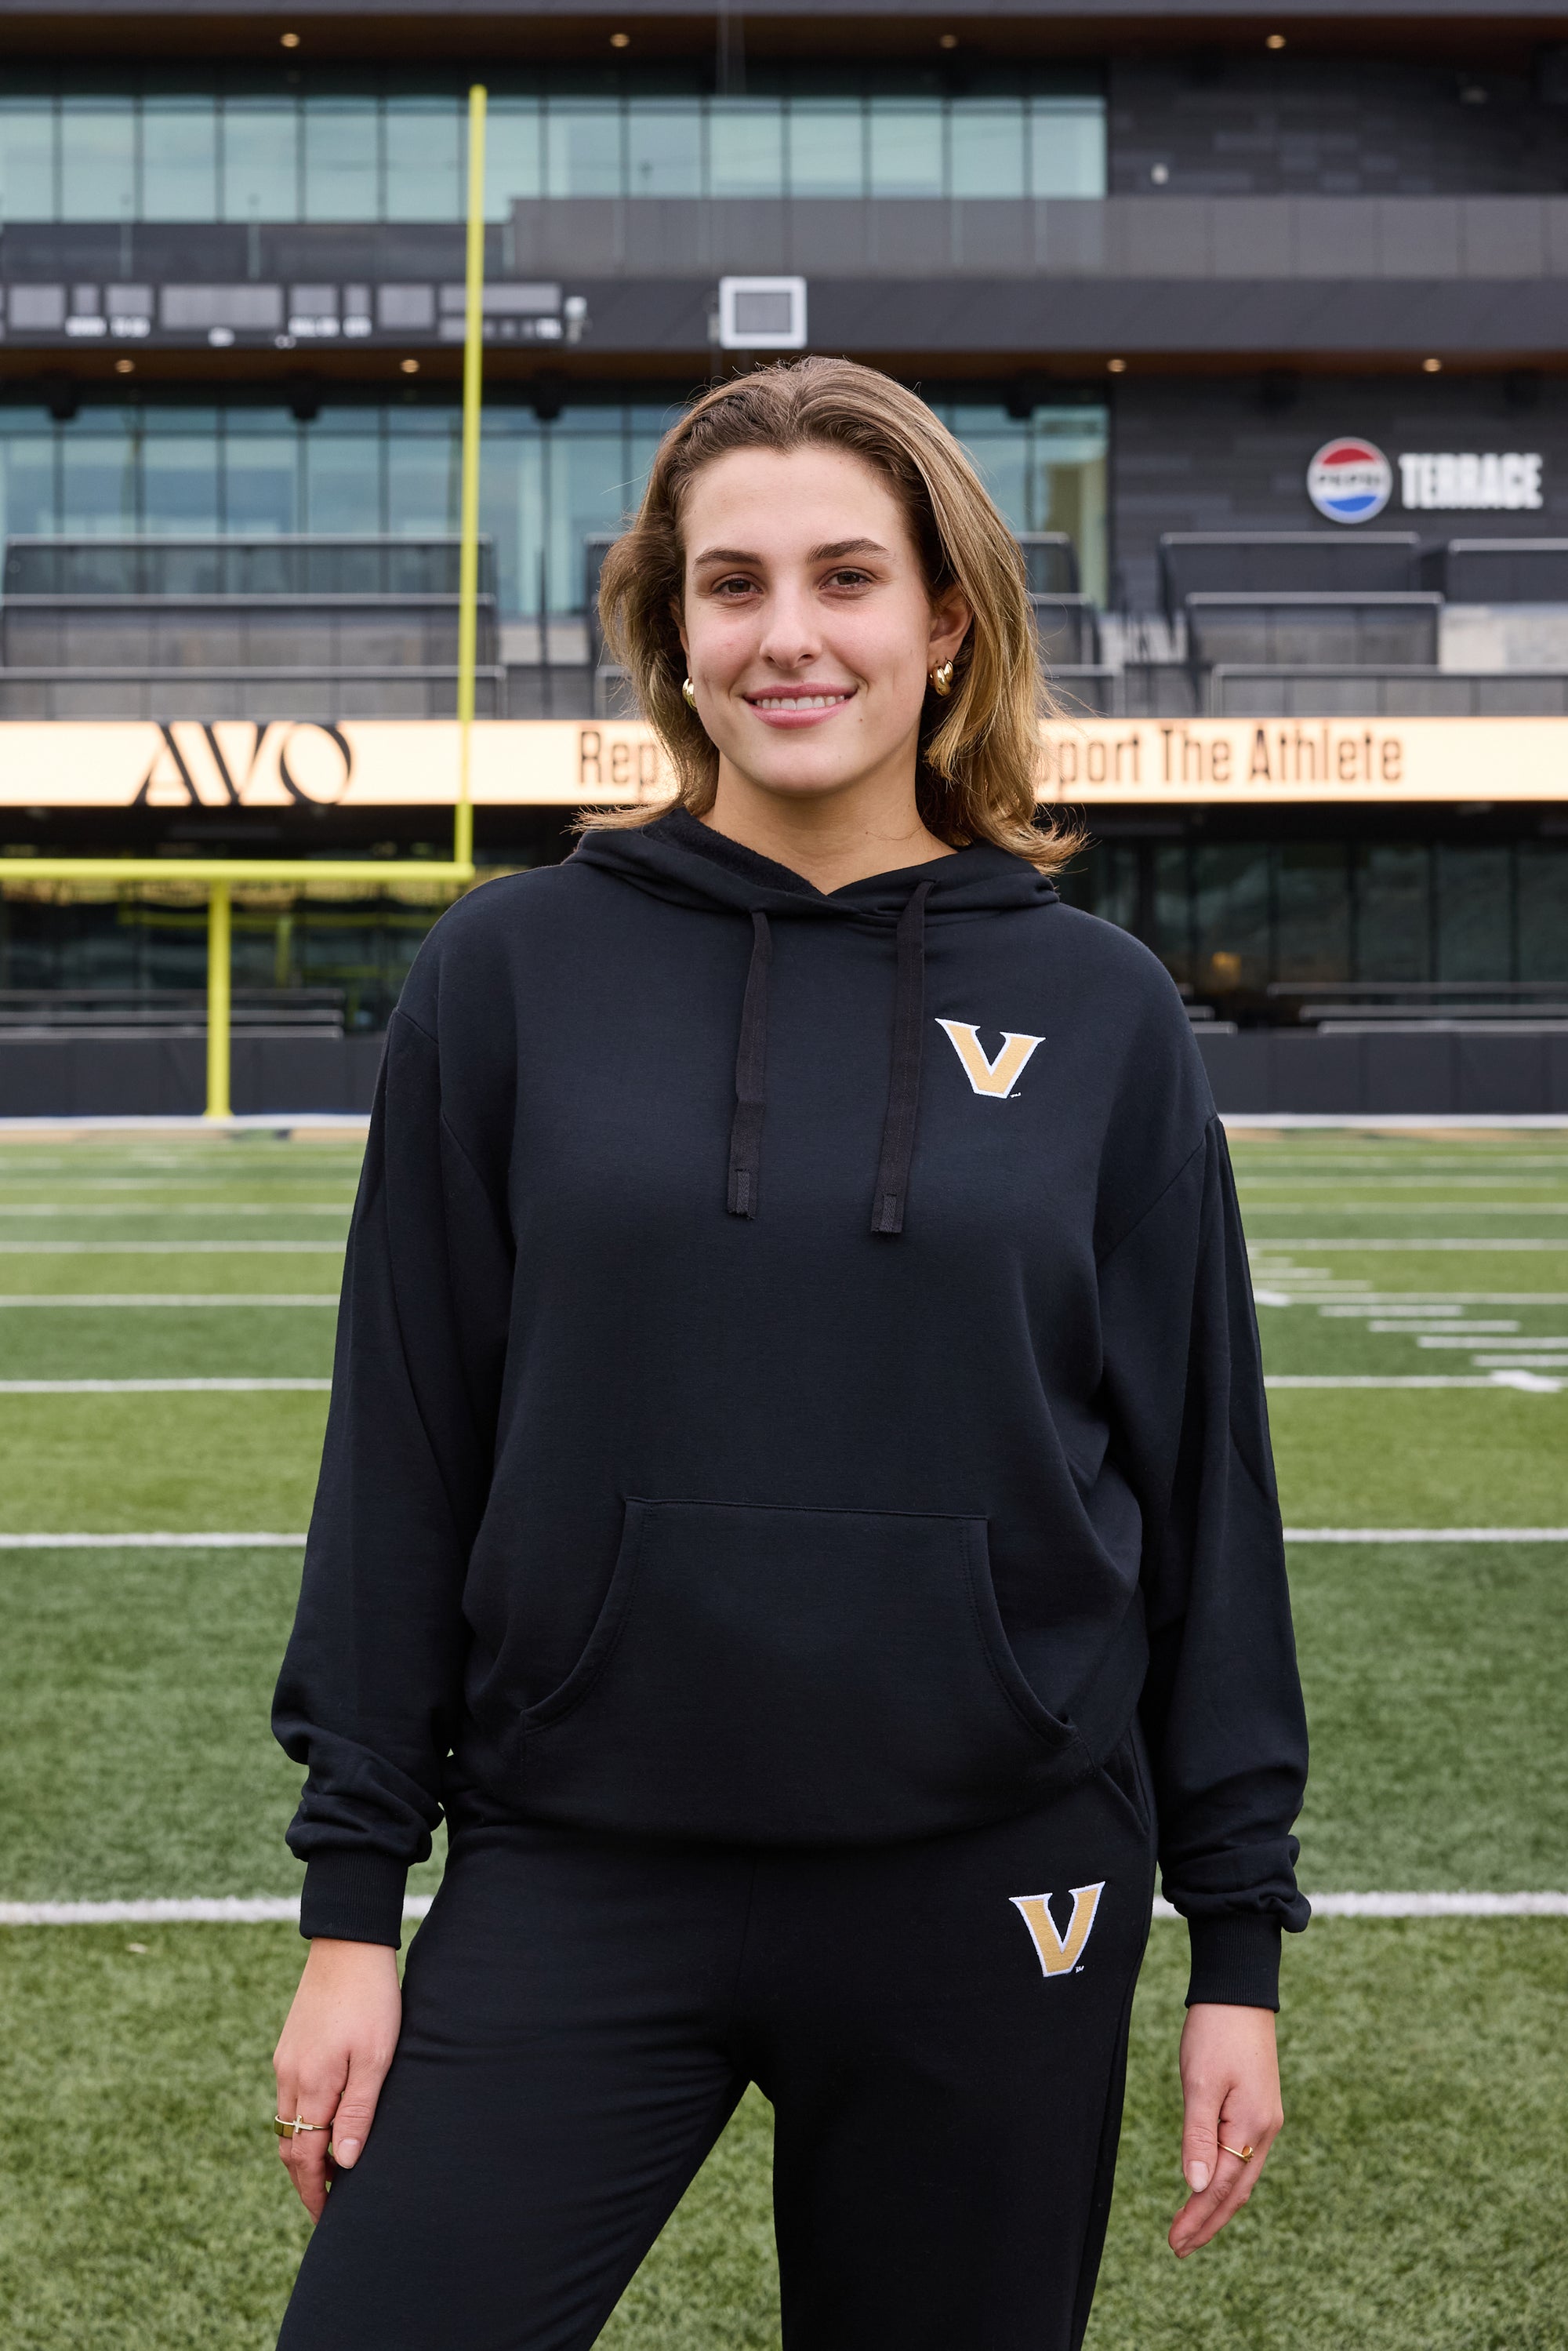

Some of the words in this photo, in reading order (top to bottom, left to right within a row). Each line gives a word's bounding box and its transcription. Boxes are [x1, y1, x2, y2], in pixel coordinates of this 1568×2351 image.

[1399, 452, 1542, 509] TERRACE
[131, 722, 355, 806] AVO
[578, 730, 659, 797] Rep
[1040, 734, 1140, 797] port
[1160, 728, 1231, 783] The
[1249, 728, 1403, 783] Athlete
[935, 1018, 1046, 1099] V
[1008, 1880, 1105, 1977] V
